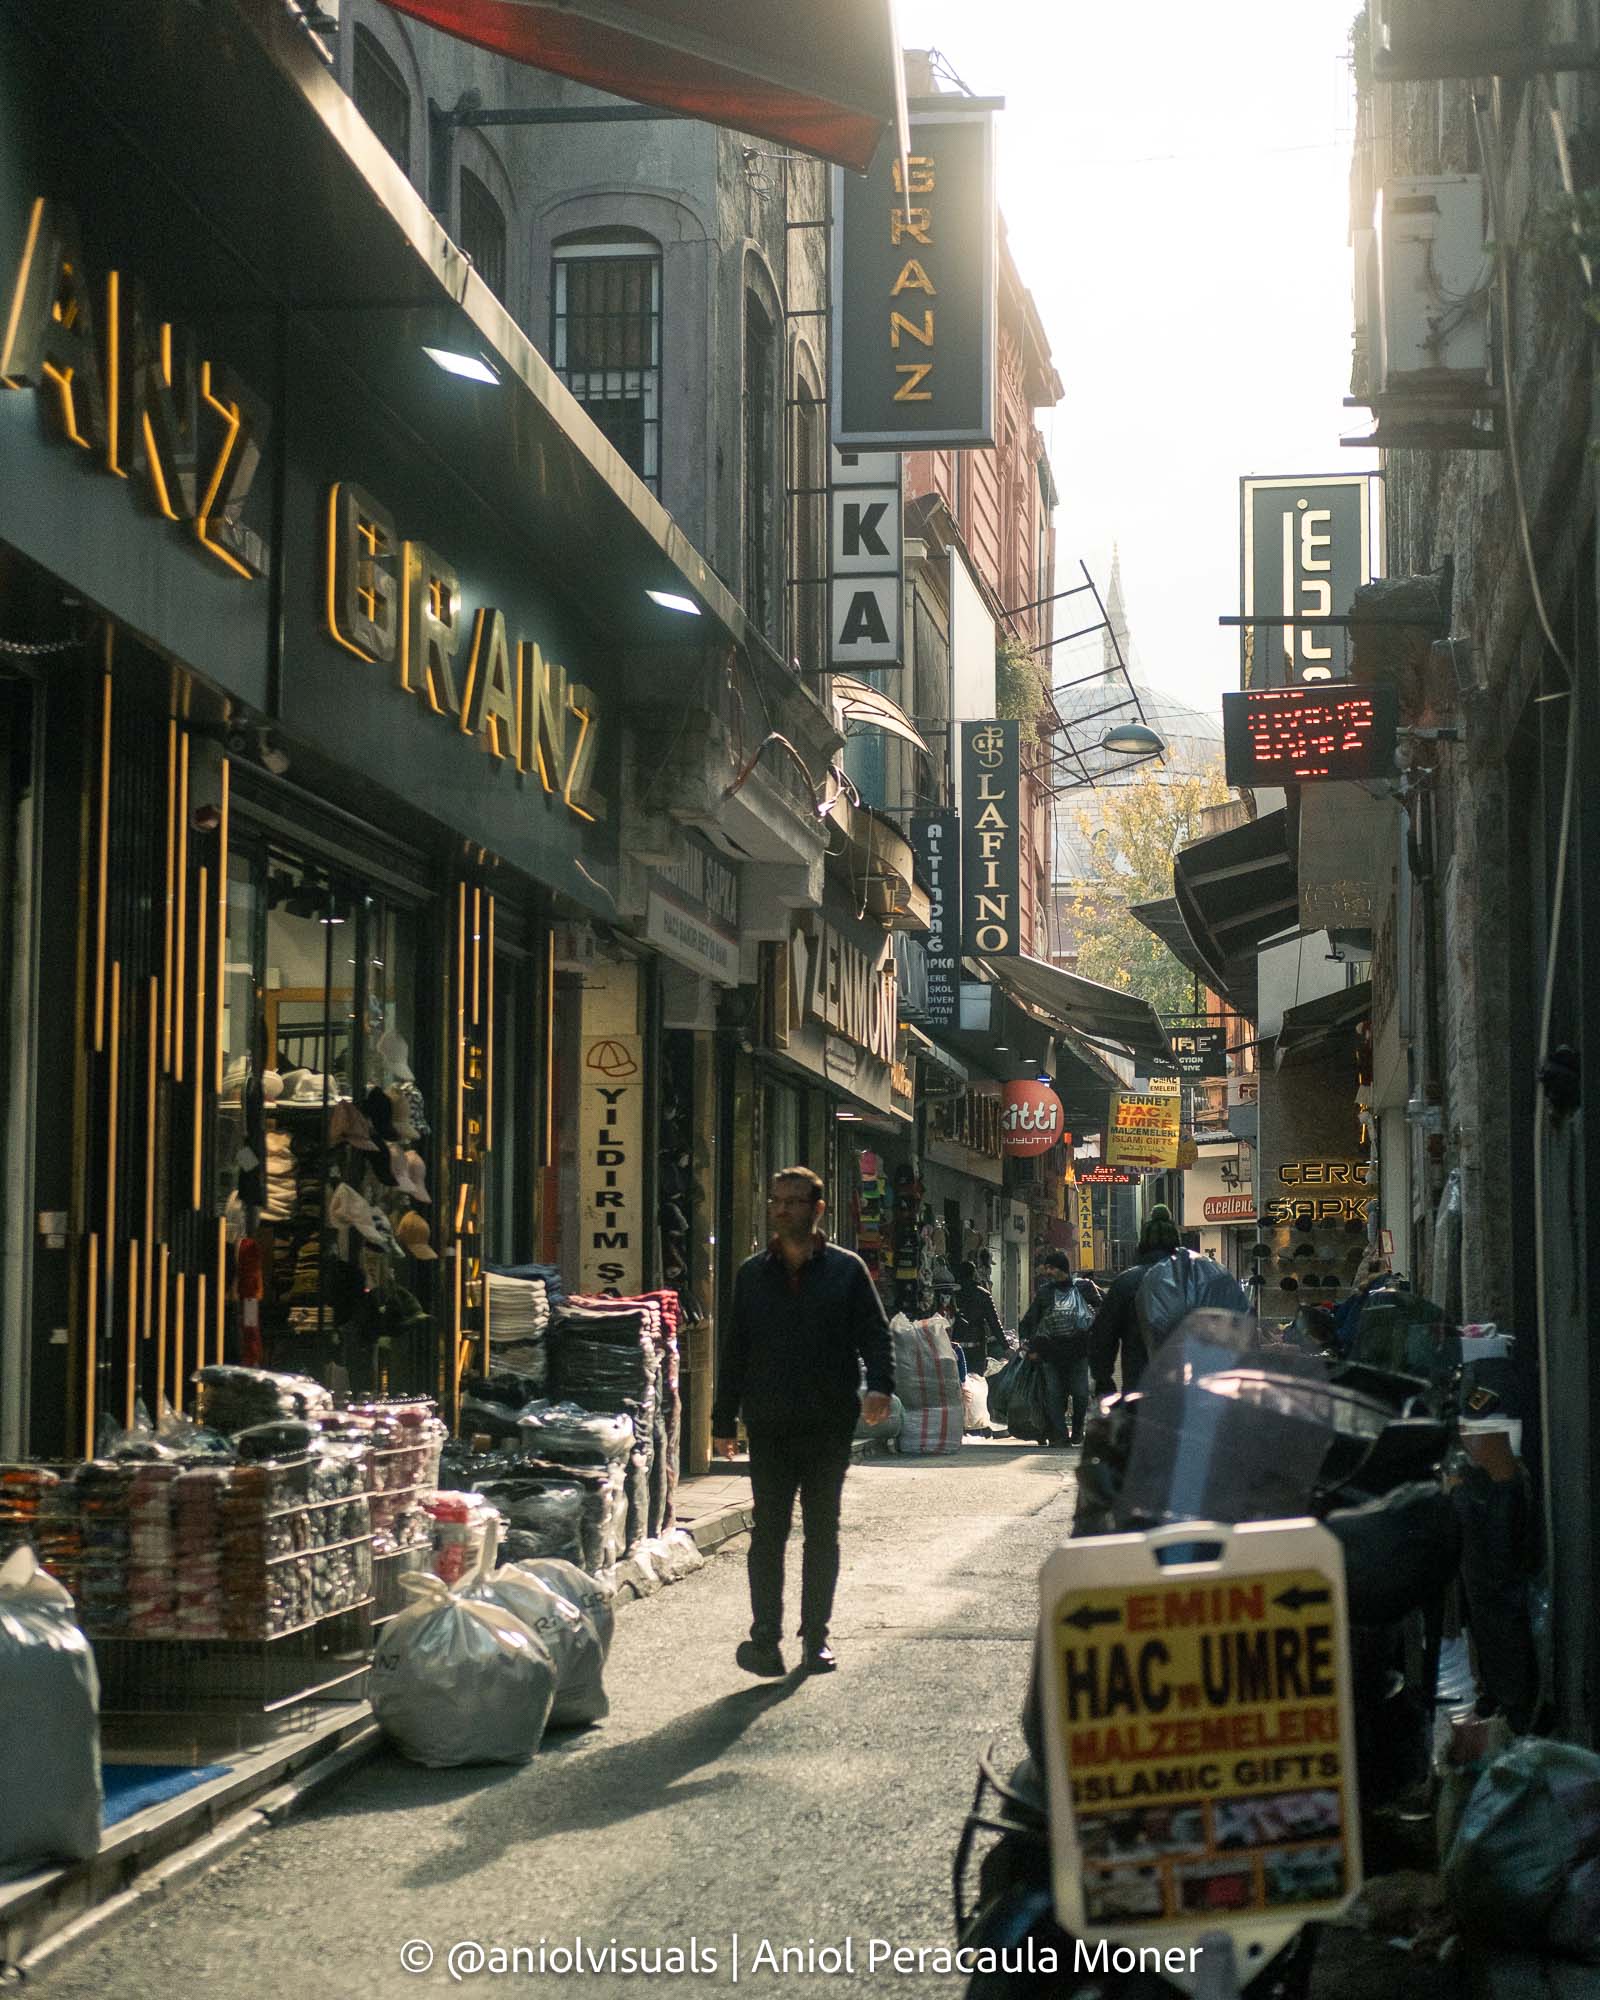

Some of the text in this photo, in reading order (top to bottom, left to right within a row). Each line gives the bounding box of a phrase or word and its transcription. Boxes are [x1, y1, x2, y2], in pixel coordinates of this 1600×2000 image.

[891, 156, 937, 402] GRANZ
[838, 455, 891, 645] KA
[327, 481, 607, 823] GRANZ
[974, 773, 1009, 953] LAFINO
[1115, 1116, 1174, 1129] UMRE
[1117, 1105, 1160, 1117] HAC
[1120, 1095, 1170, 1107] CENNET
[592, 1087, 629, 1250] YILDIRIM
[1125, 1584, 1269, 1633] EMIN
[1064, 1626, 1333, 1721] HAC UMRE
[1234, 1752, 1339, 1786] GIFTS
